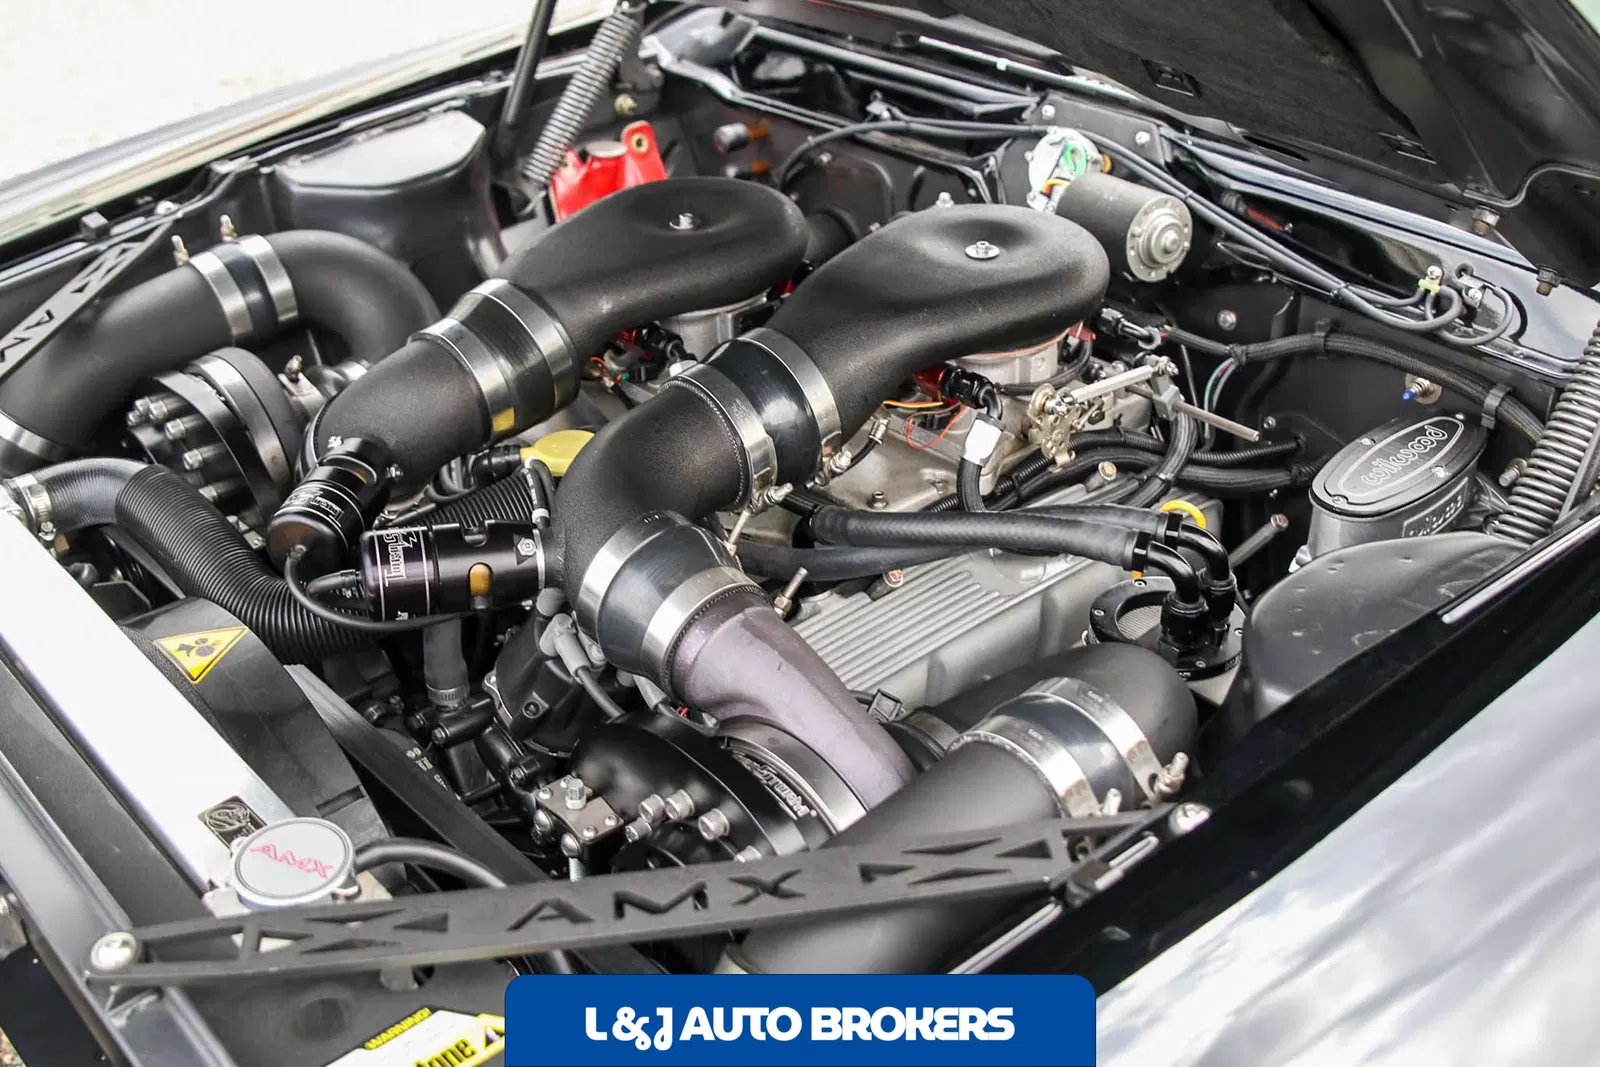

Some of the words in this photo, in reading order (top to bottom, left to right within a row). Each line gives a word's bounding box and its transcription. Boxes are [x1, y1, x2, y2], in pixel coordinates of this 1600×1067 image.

[1361, 424, 1448, 485] wilwood
[249, 842, 334, 880] AMX
[506, 867, 807, 931] AMX
